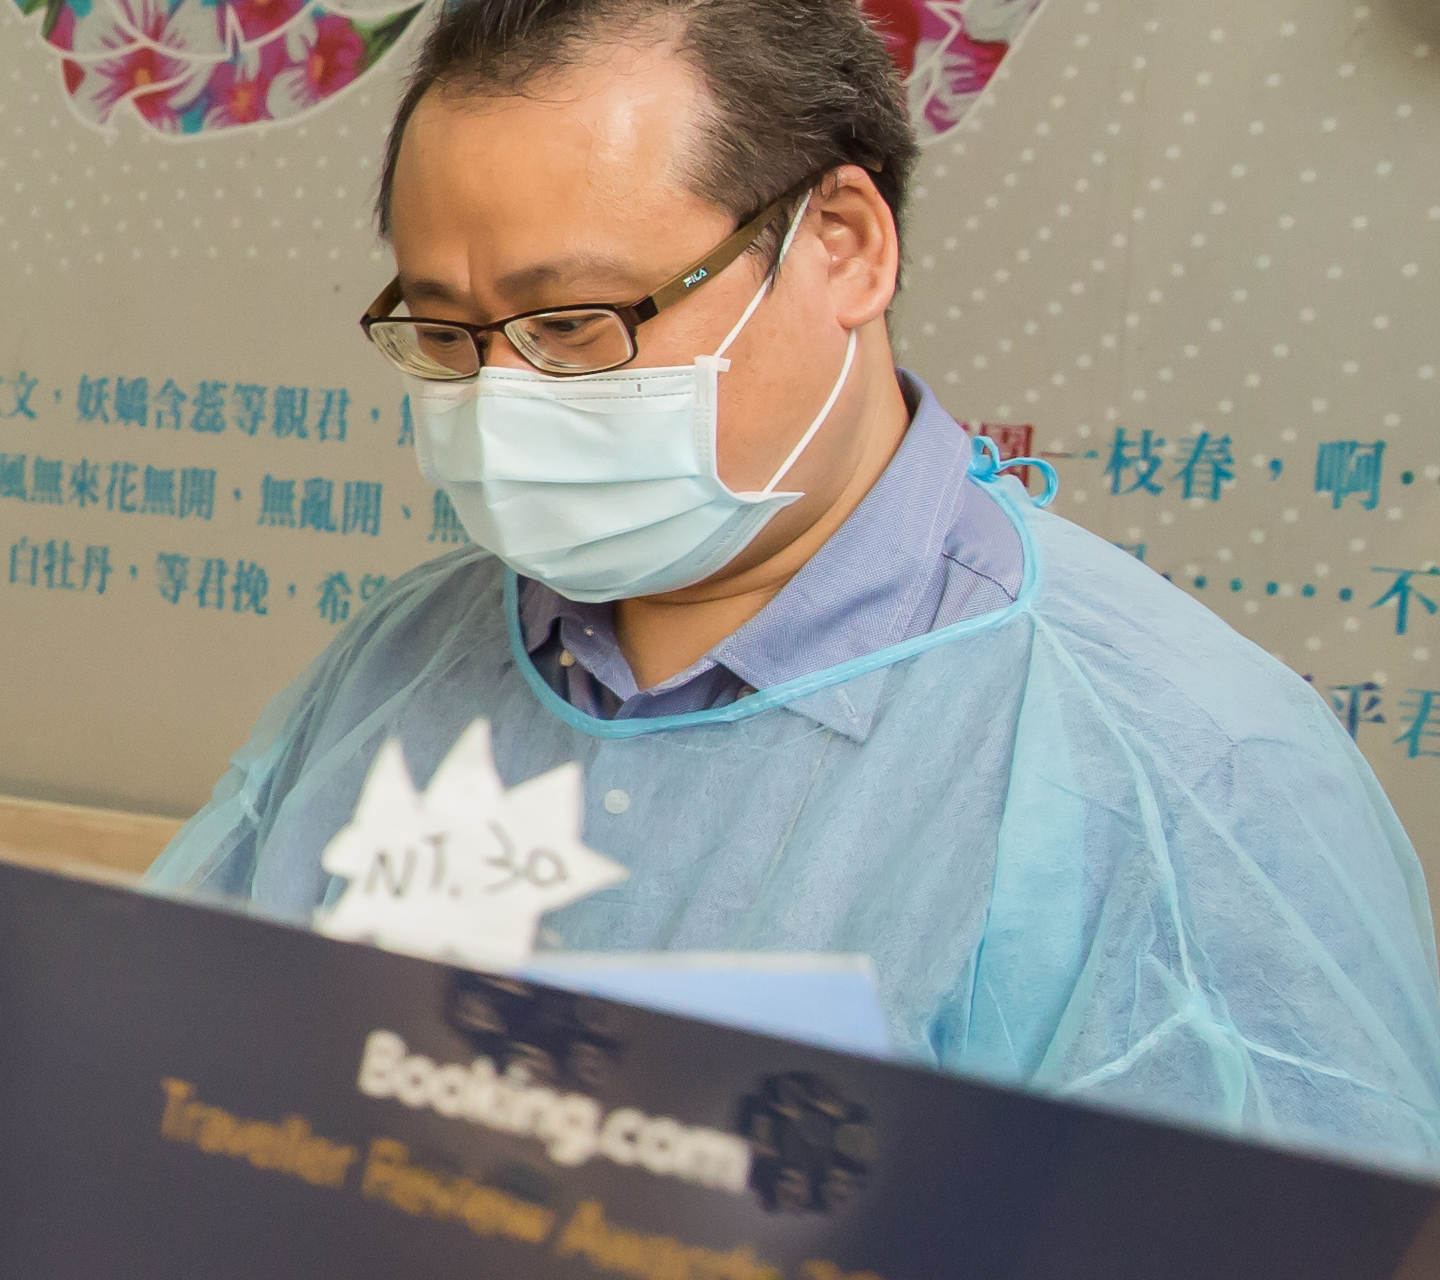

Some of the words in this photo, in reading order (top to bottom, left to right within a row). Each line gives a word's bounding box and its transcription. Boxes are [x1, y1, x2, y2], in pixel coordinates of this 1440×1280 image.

[159, 1075, 361, 1190] Traveller
[362, 1135, 556, 1246] Review
[357, 1027, 754, 1196] Booking.com
